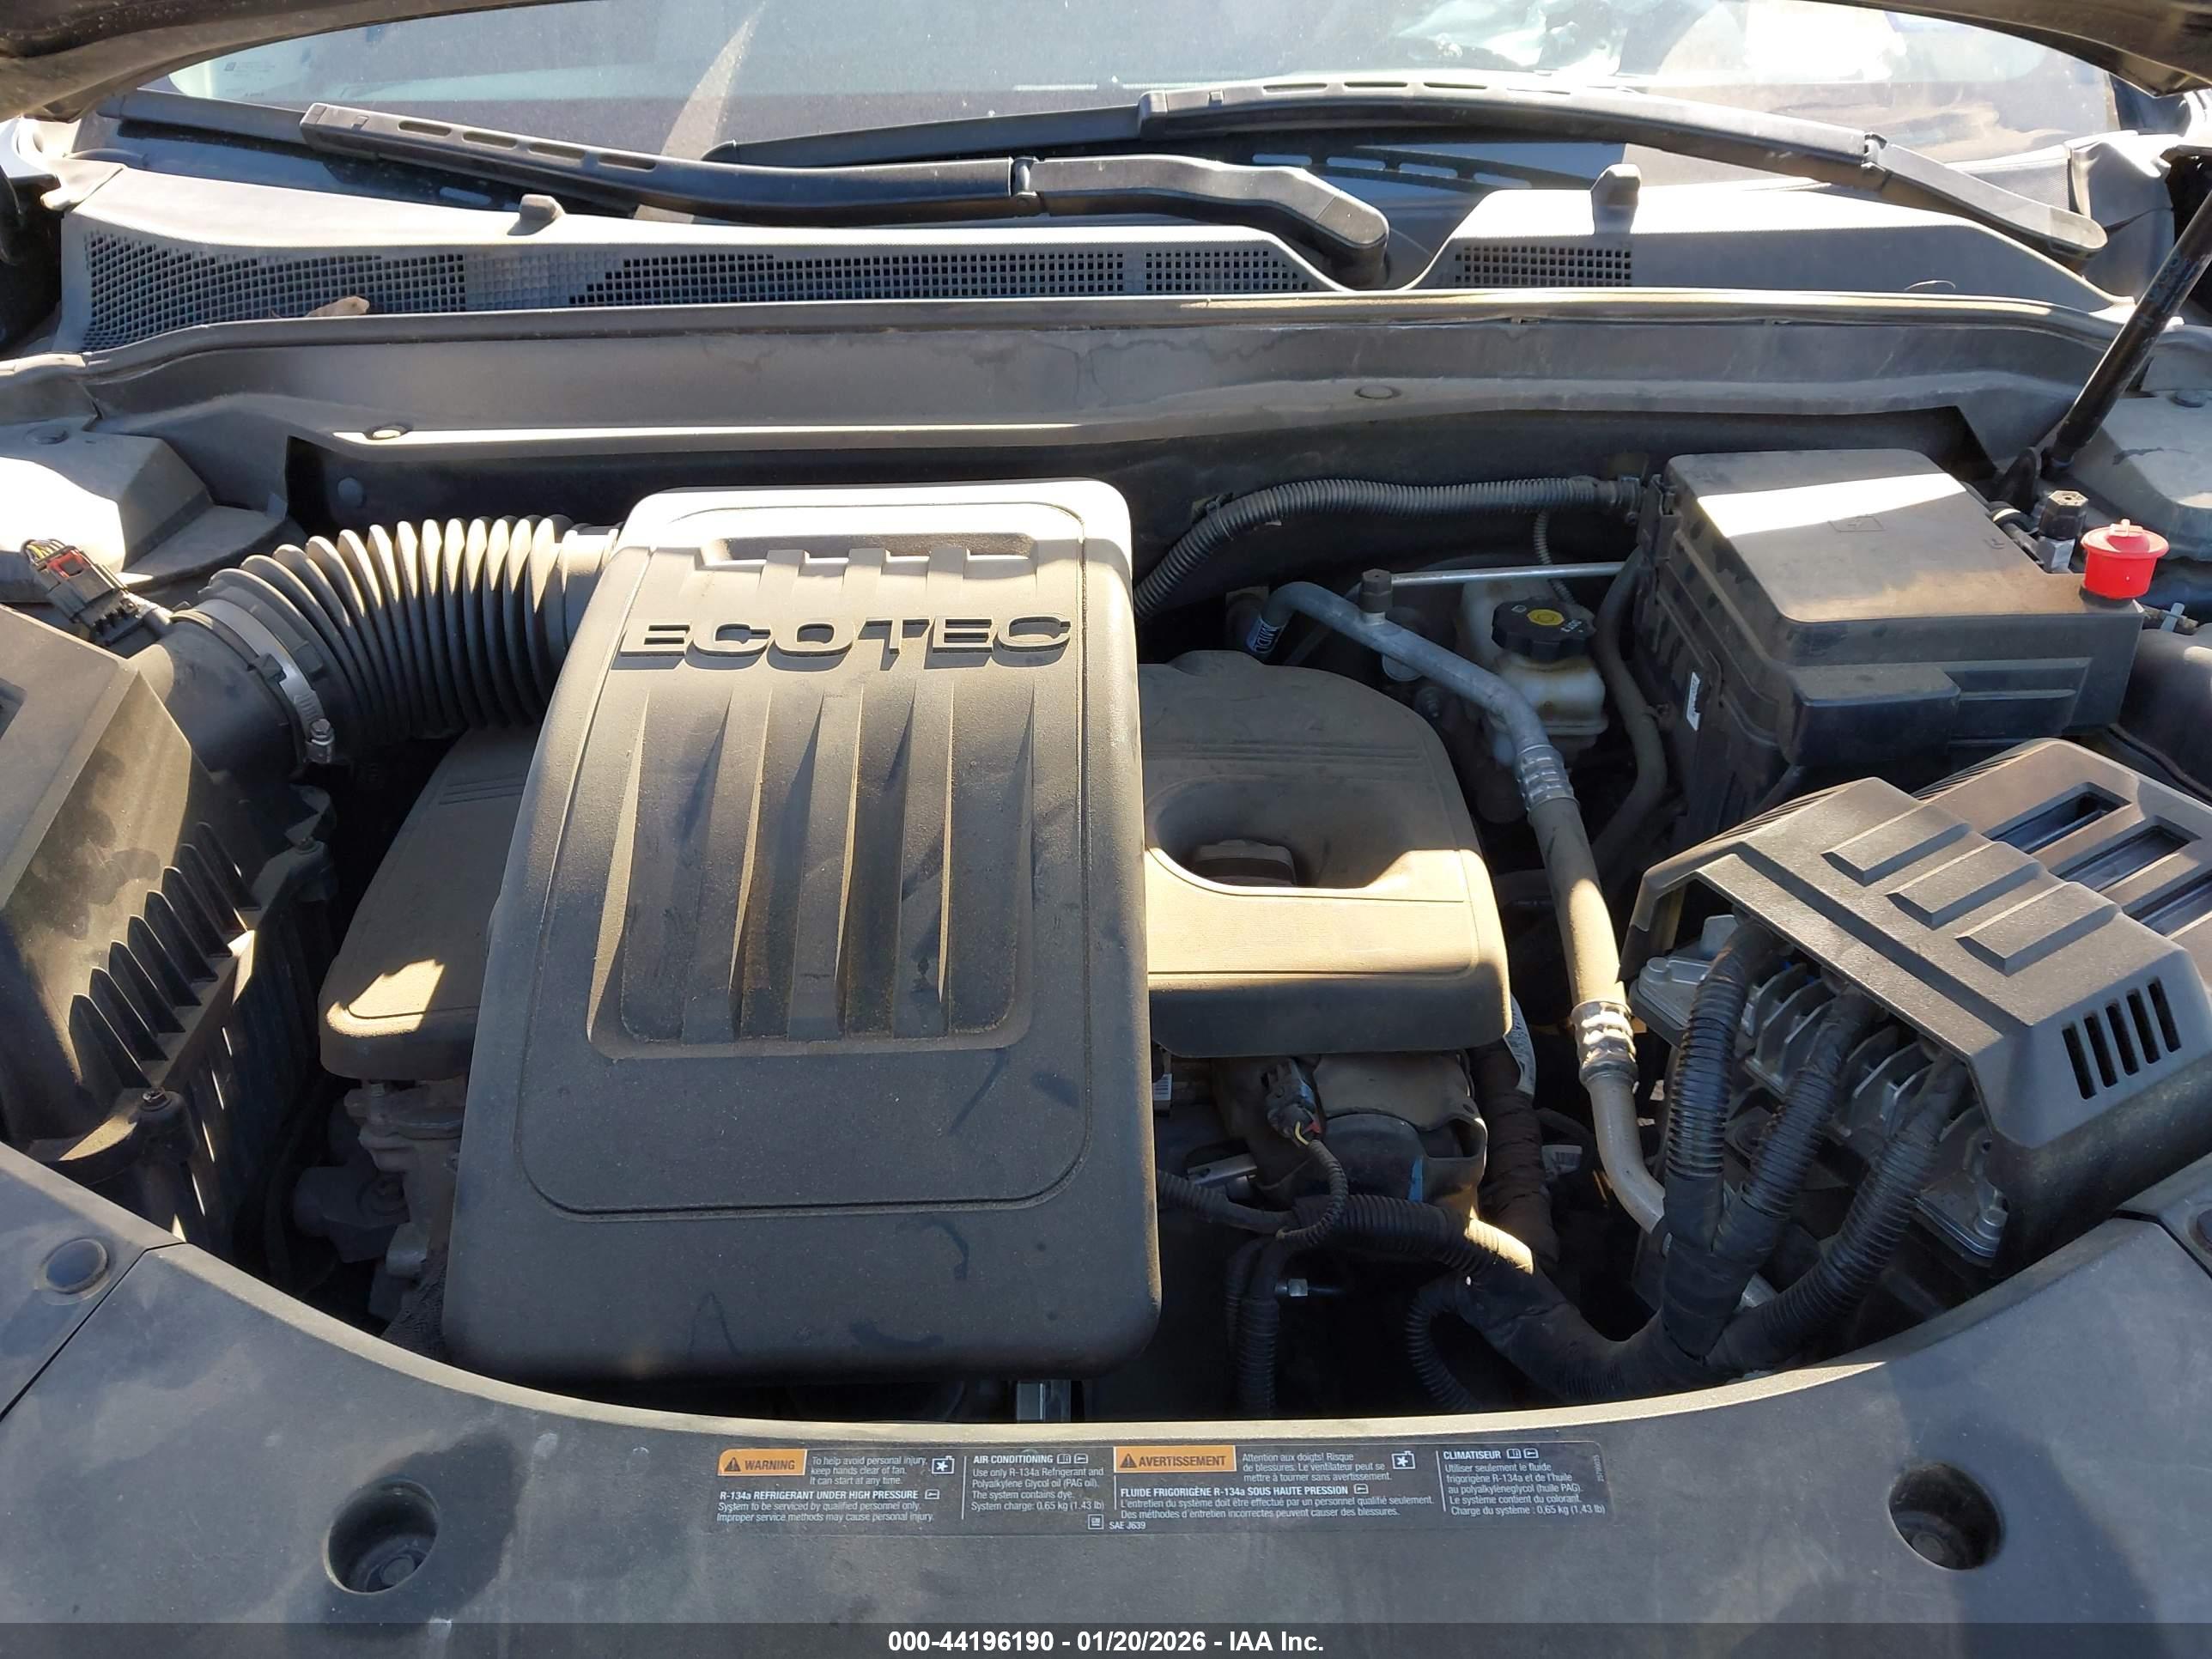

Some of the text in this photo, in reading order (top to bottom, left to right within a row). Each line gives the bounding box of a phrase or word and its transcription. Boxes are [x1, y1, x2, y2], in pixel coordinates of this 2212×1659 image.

[617, 616, 1073, 661] ECOTEC
[973, 1455, 1053, 1464] AIR CONDITIONING
[1243, 1453, 1278, 1462] Attention
[1297, 1453, 1324, 1462] doigts!
[1326, 1452, 1354, 1462] Risque
[1443, 1450, 1501, 1460] CLIMATISEUR
[744, 1460, 795, 1470] WARNING
[812, 1456, 822, 1465] To
[823, 1456, 841, 1467] help
[843, 1456, 864, 1465] avoid
[866, 1456, 902, 1466] personal
[1139, 1455, 1226, 1467] AVERTISSEMENT
[811, 1466, 907, 1476] keep hands clear of fan.
[1243, 1463, 1254, 1472] de
[1255, 1463, 1296, 1472] blessures.
[1310, 1462, 1352, 1471] ventilateur
[1355, 1462, 1373, 1472] peut
[1445, 1464, 1473, 1473] Utiliser
[1474, 1463, 1517, 1472] seulement
[1528, 1462, 1552, 1471] fluide
[973, 1468, 988, 1477] Use
[990, 1468, 1006, 1479] only
[1042, 1468, 1086, 1477] Refrigerant
[1088, 1468, 1104, 1476] and
[1243, 1474, 1271, 1482] mettre
[1273, 1473, 1278, 1482] à
[1279, 1474, 1309, 1482] tourner
[1333, 1472, 1392, 1481] avertissement.
[866, 1478, 879, 1486] any
[972, 1479, 1099, 1489] Polyalkylene Glycol oil (PAG oil).
[1447, 1474, 1491, 1485] frigorigène
[1492, 1474, 1523, 1482] R-134a
[1535, 1474, 1546, 1482] de
[1120, 1486, 1348, 1498] FLUIDE FRIGORIGÈNE R-134a SOUS HAUTE PRESSION
[1536, 1484, 1559, 1493] (huile
[720, 1490, 919, 1500] R-134a REFRIGERANT UNDER HIGH PRESSURE
[972, 1490, 1073, 1500] The system contains dye.
[1462, 1495, 1496, 1506] système
[1498, 1495, 1531, 1504] contient
[1534, 1495, 1544, 1504] du
[1546, 1494, 1581, 1503] colorant.
[718, 1501, 921, 1512] System to be serviced by qualified personnel only.
[971, 1502, 1002, 1511] System
[1004, 1502, 1033, 1511] charge:
[1057, 1501, 1068, 1511] kg
[1070, 1501, 1092, 1511] (1.43
[1094, 1501, 1104, 1510] lb)
[1165, 1499, 1176, 1508] du
[1179, 1498, 1213, 1509] système
[1215, 1498, 1231, 1507] doit
[1232, 1498, 1249, 1506] être
[1251, 1498, 1284, 1506] effectué
[1286, 1498, 1299, 1507] par
[1315, 1498, 1355, 1507] personnel
[1357, 1496, 1387, 1506] qualifié
[1389, 1496, 1434, 1504] seulement.
[1121, 1510, 1137, 1519] Des
[1139, 1510, 1180, 1519] méthodes
[1228, 1509, 1273, 1518] incorrectes
[1276, 1509, 1310, 1518] peuvent
[1340, 1508, 1356, 1516] des
[1358, 1507, 1400, 1516] blessures.
[1451, 1506, 1480, 1516] Charge
[1483, 1506, 1494, 1515] du
[1496, 1505, 1530, 1516] système
[1558, 1504, 1569, 1516] kg
[1594, 1504, 1606, 1514] lb)
[717, 1513, 754, 1522] Improper
[756, 1513, 786, 1522] service
[787, 1513, 823, 1522] methods
[826, 1513, 843, 1522] may
[872, 1512, 908, 1522] personal
[1109, 1521, 1146, 1530] SAE J639
